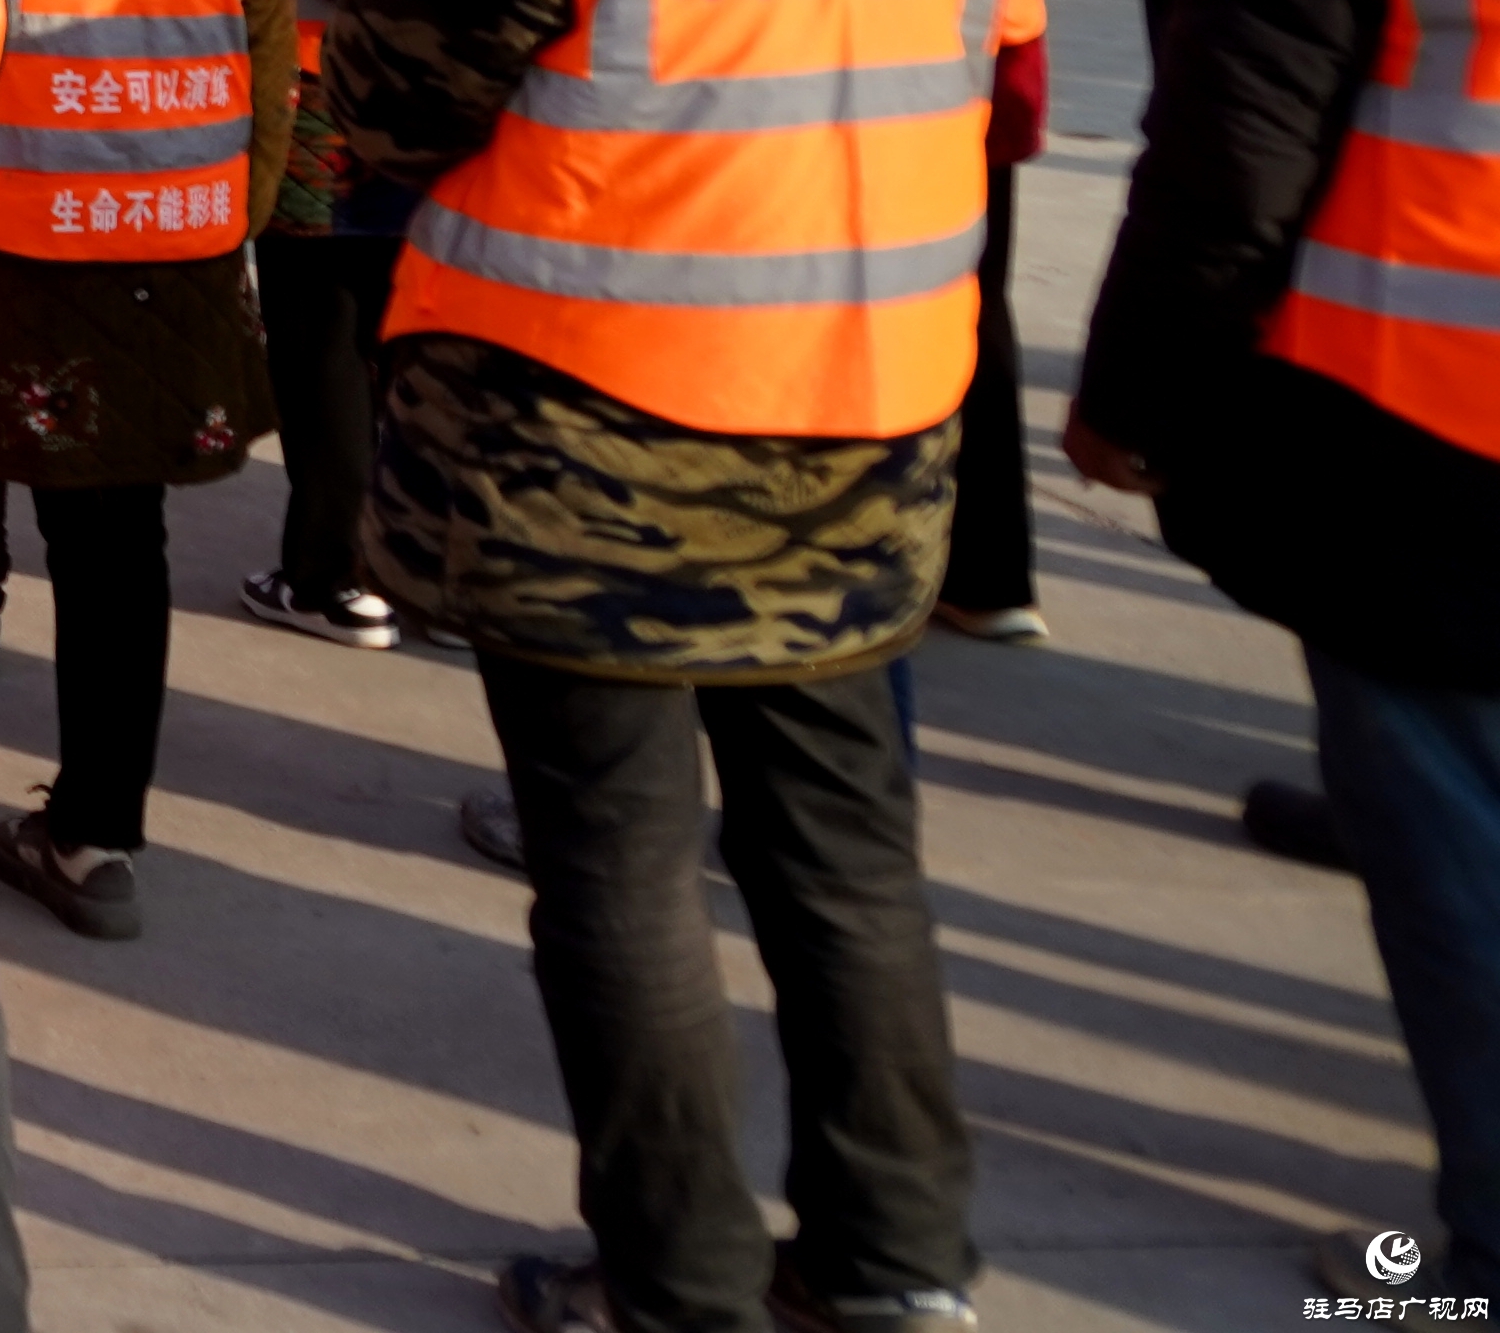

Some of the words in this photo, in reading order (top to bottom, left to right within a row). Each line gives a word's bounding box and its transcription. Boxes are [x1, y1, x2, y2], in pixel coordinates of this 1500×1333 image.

[51, 66, 233, 114] 安全可以演练
[50, 180, 232, 235] 生命不能彩排
